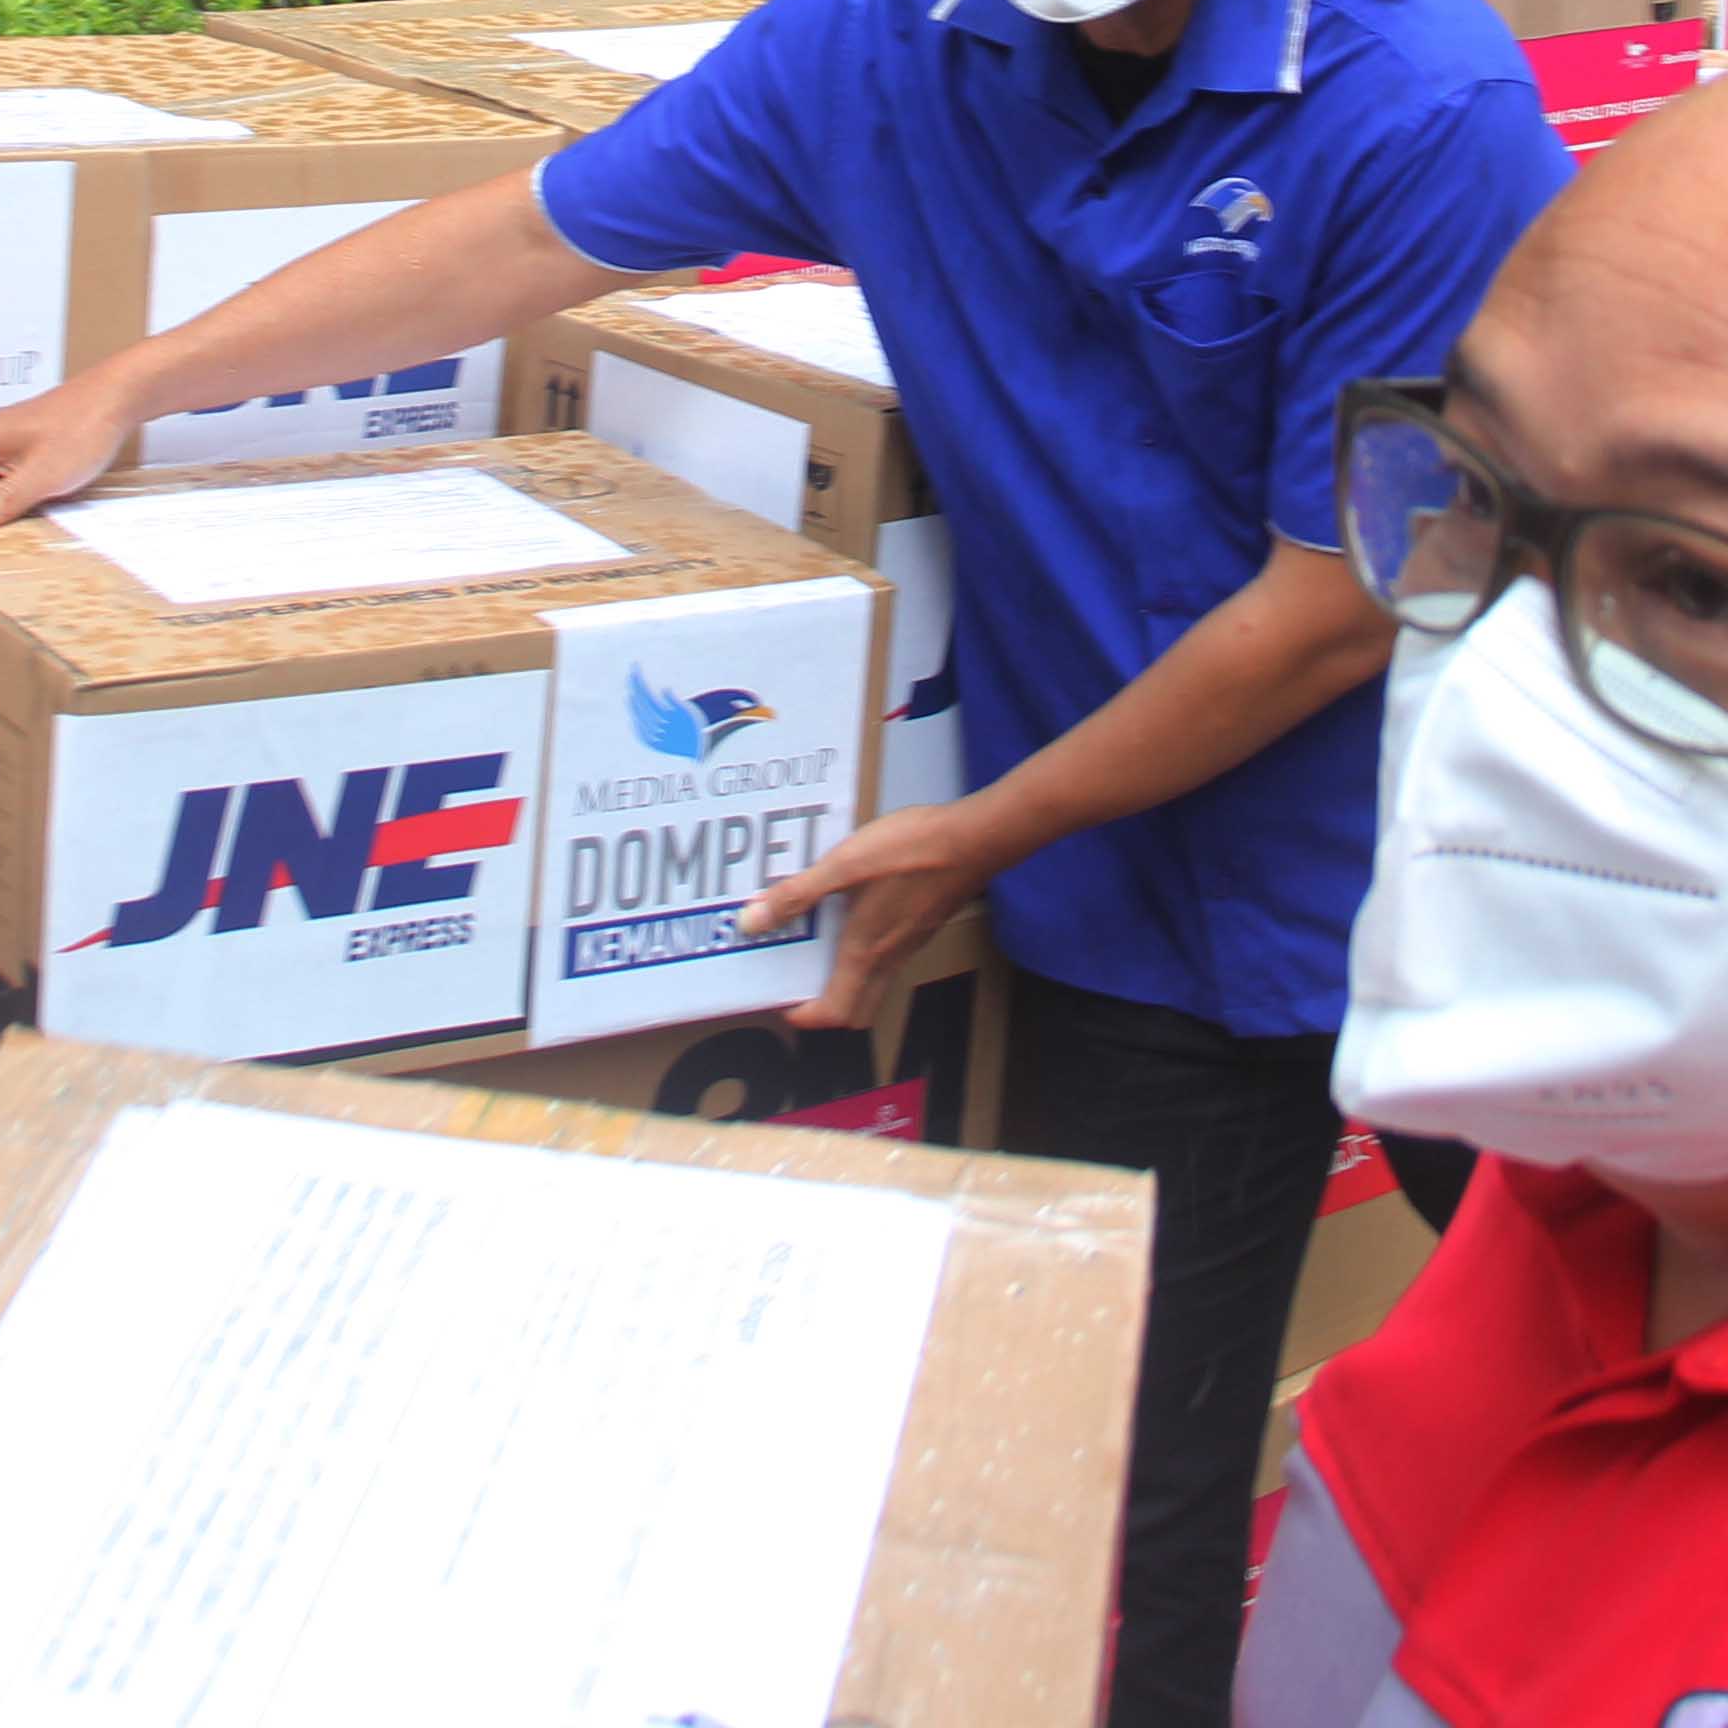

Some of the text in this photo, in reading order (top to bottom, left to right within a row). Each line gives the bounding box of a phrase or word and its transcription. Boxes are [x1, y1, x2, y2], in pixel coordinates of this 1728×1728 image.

[571, 746, 840, 816] MEDIA GROUP
[55, 750, 526, 954] JNE
[564, 802, 834, 920] DOMPET
[343, 912, 478, 962] EXPRESS
